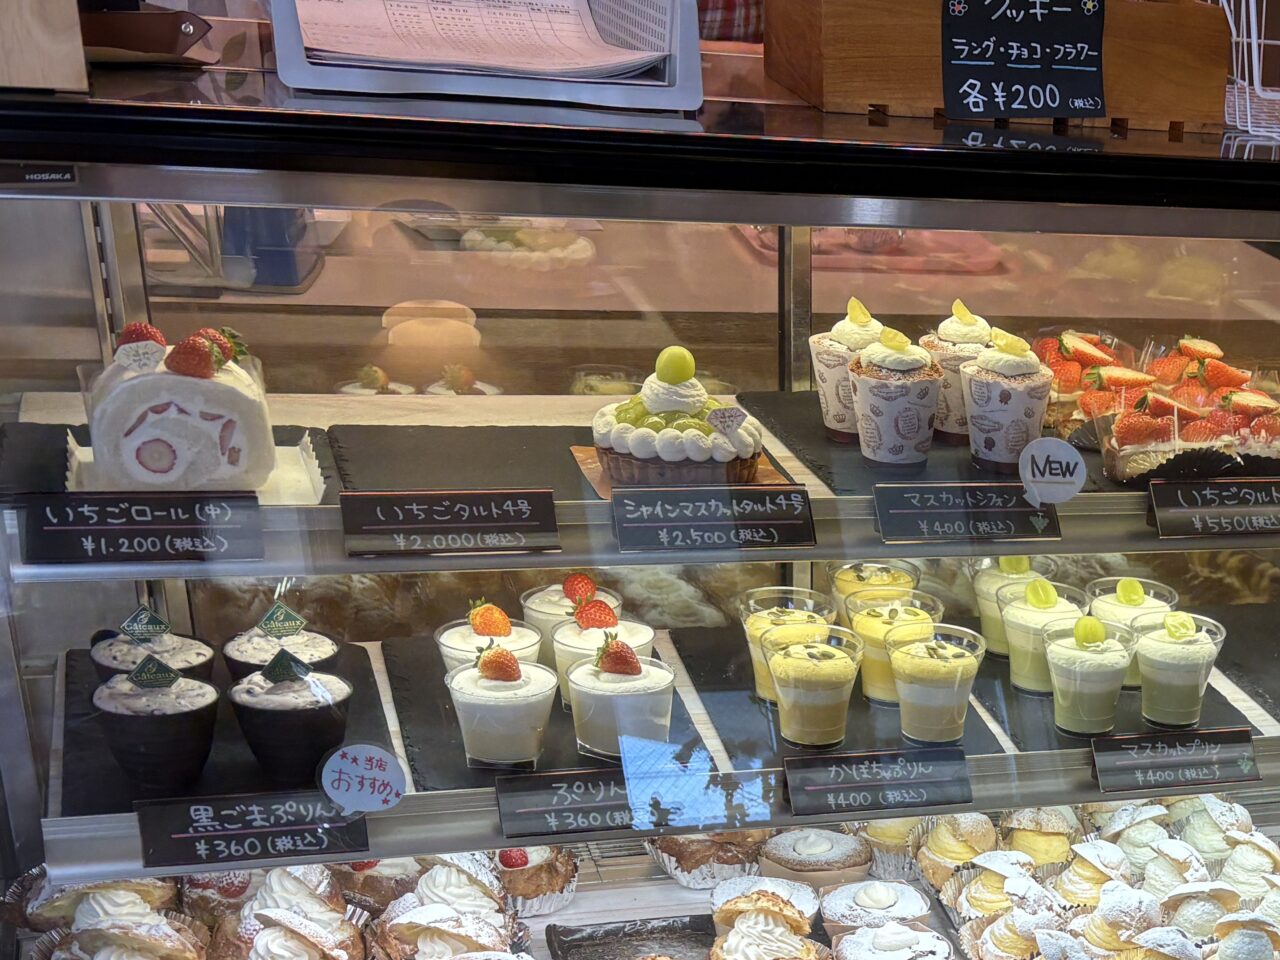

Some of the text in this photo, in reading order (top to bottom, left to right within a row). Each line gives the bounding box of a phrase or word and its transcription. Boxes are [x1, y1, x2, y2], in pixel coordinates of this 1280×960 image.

[1030, 454, 1079, 479] NEW
[364, 755, 388, 773] 当店
[331, 768, 394, 798] おすすめ
